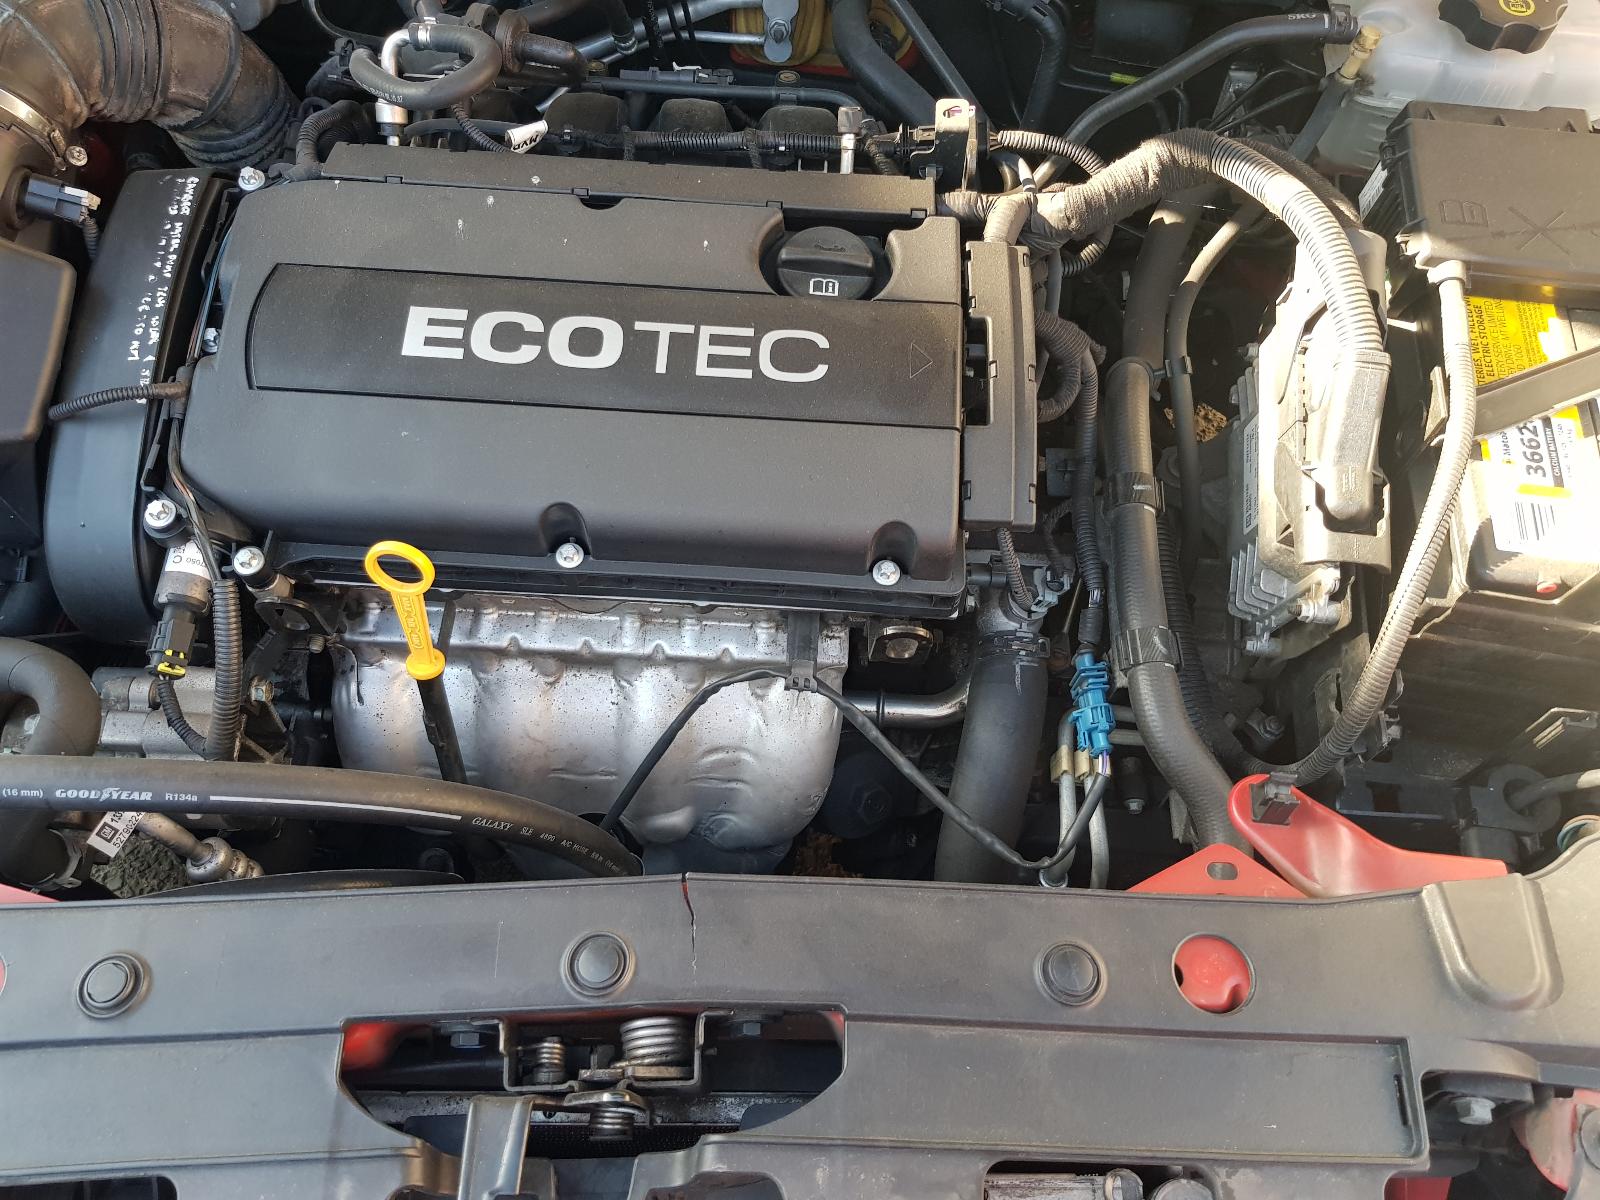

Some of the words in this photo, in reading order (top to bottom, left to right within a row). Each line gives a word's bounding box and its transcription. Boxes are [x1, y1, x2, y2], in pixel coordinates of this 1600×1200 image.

[1473, 304, 1488, 340] STORAGE
[1484, 300, 1496, 327] LIMITED
[402, 306, 830, 382] ECOTEC
[1489, 329, 1503, 358] SERVICE
[1480, 341, 1494, 377] ELECTRIC
[1549, 452, 1561, 477] CALCIUM
[2, 788, 18, 797] (16
[20, 789, 43, 798] mm)
[56, 788, 152, 801] GOODYEAR
[165, 792, 198, 802] R134a
[472, 817, 514, 831] GALAXY
[520, 826, 534, 836] SLE
